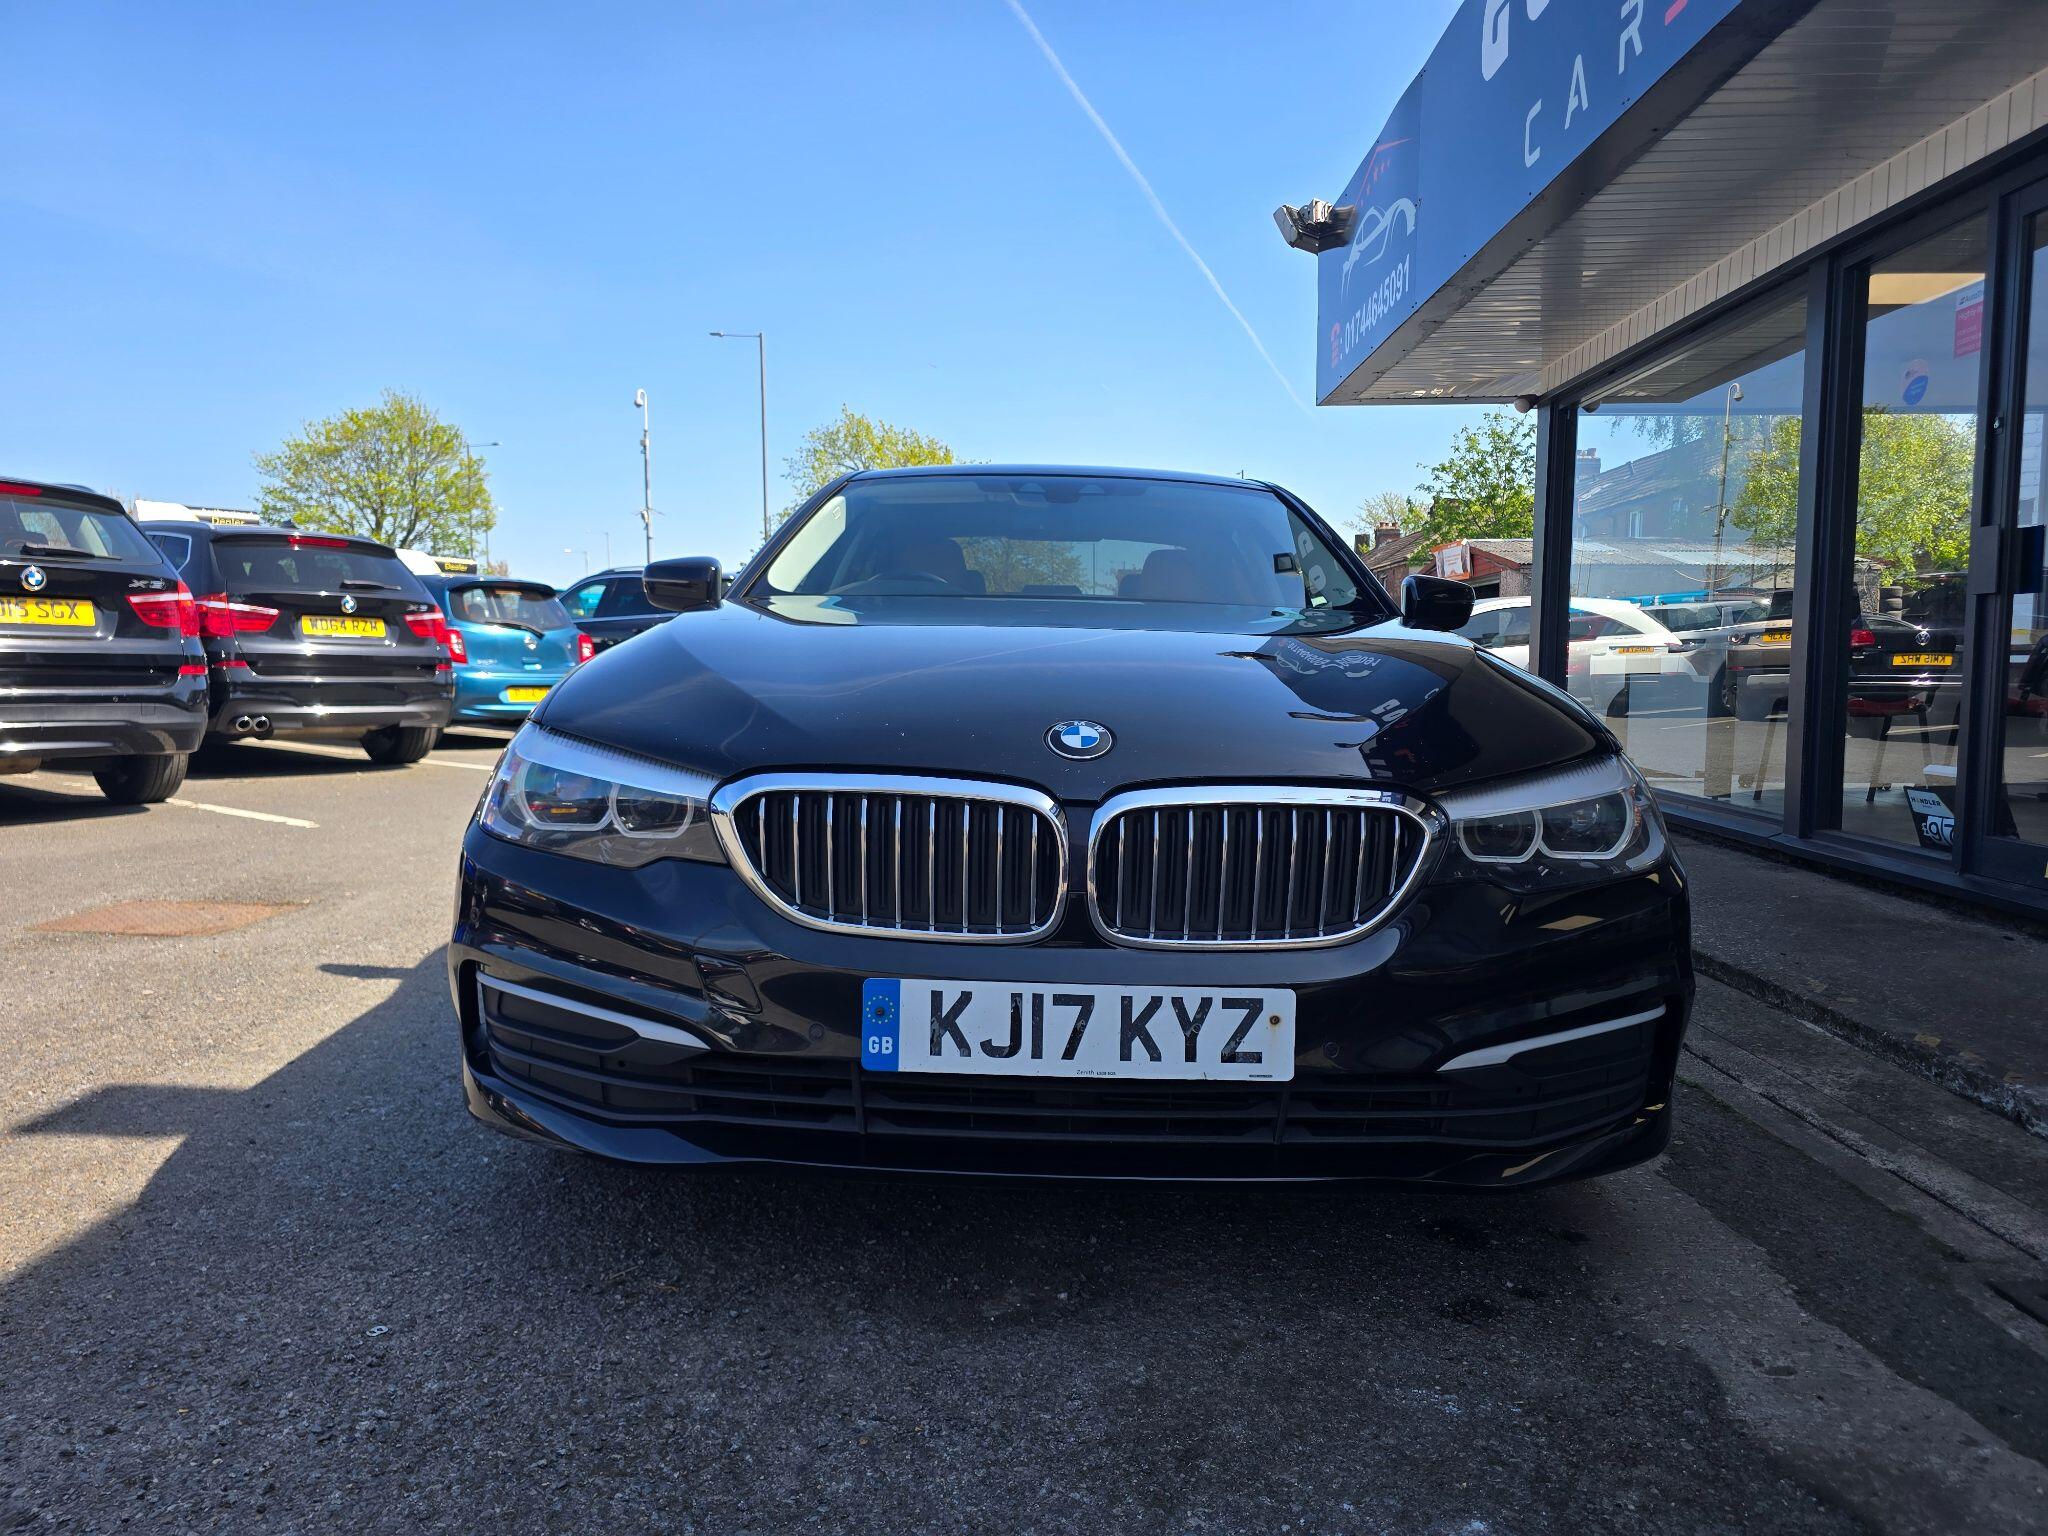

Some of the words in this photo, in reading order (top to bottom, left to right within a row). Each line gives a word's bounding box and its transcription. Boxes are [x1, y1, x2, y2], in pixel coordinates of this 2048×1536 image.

[35, 599, 79, 620] SGX
[929, 989, 1095, 1060] KJ17
[1119, 995, 1264, 1064] KYZ
[868, 1036, 893, 1054] GB
